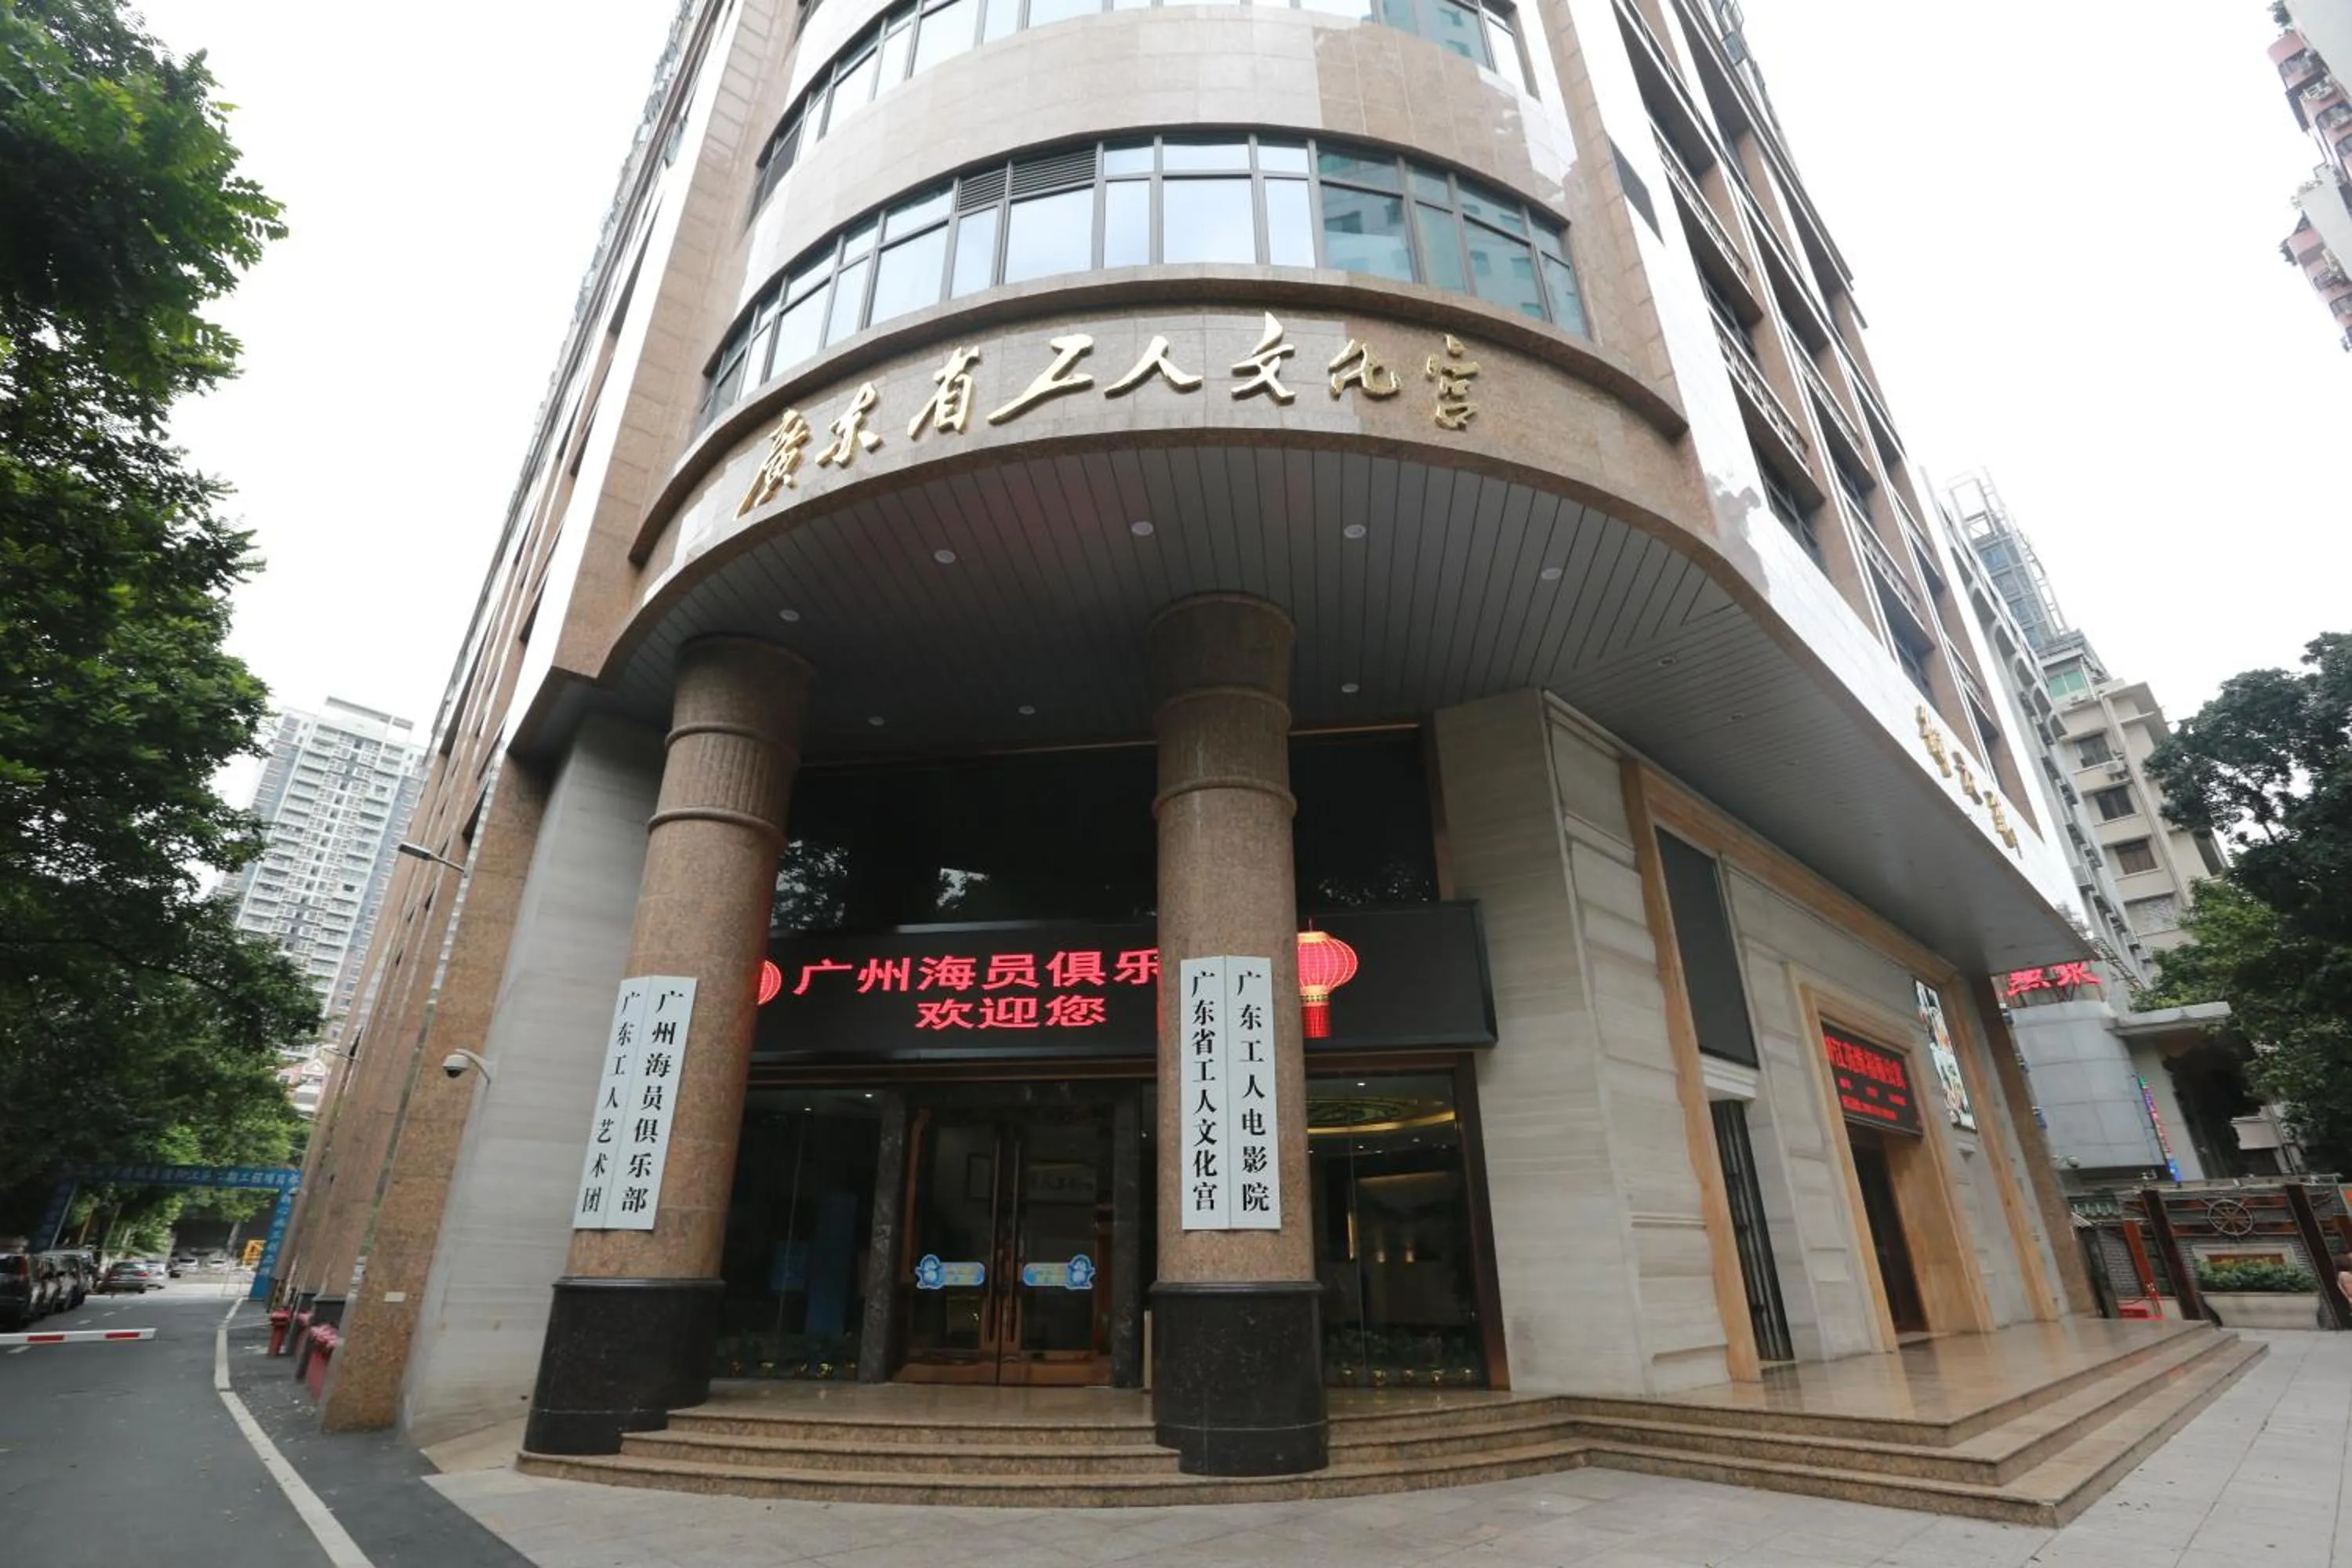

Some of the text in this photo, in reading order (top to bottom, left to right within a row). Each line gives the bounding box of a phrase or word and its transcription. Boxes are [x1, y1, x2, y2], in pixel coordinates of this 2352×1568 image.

[582, 991, 641, 1213] 广东工人艺术团
[622, 990, 684, 1214] 广州海员俱乐部
[915, 994, 1106, 1030] 欢迎您
[1191, 971, 1218, 1211] 广东省工人文化宫
[1236, 971, 1270, 1212] 广东工人电影院
